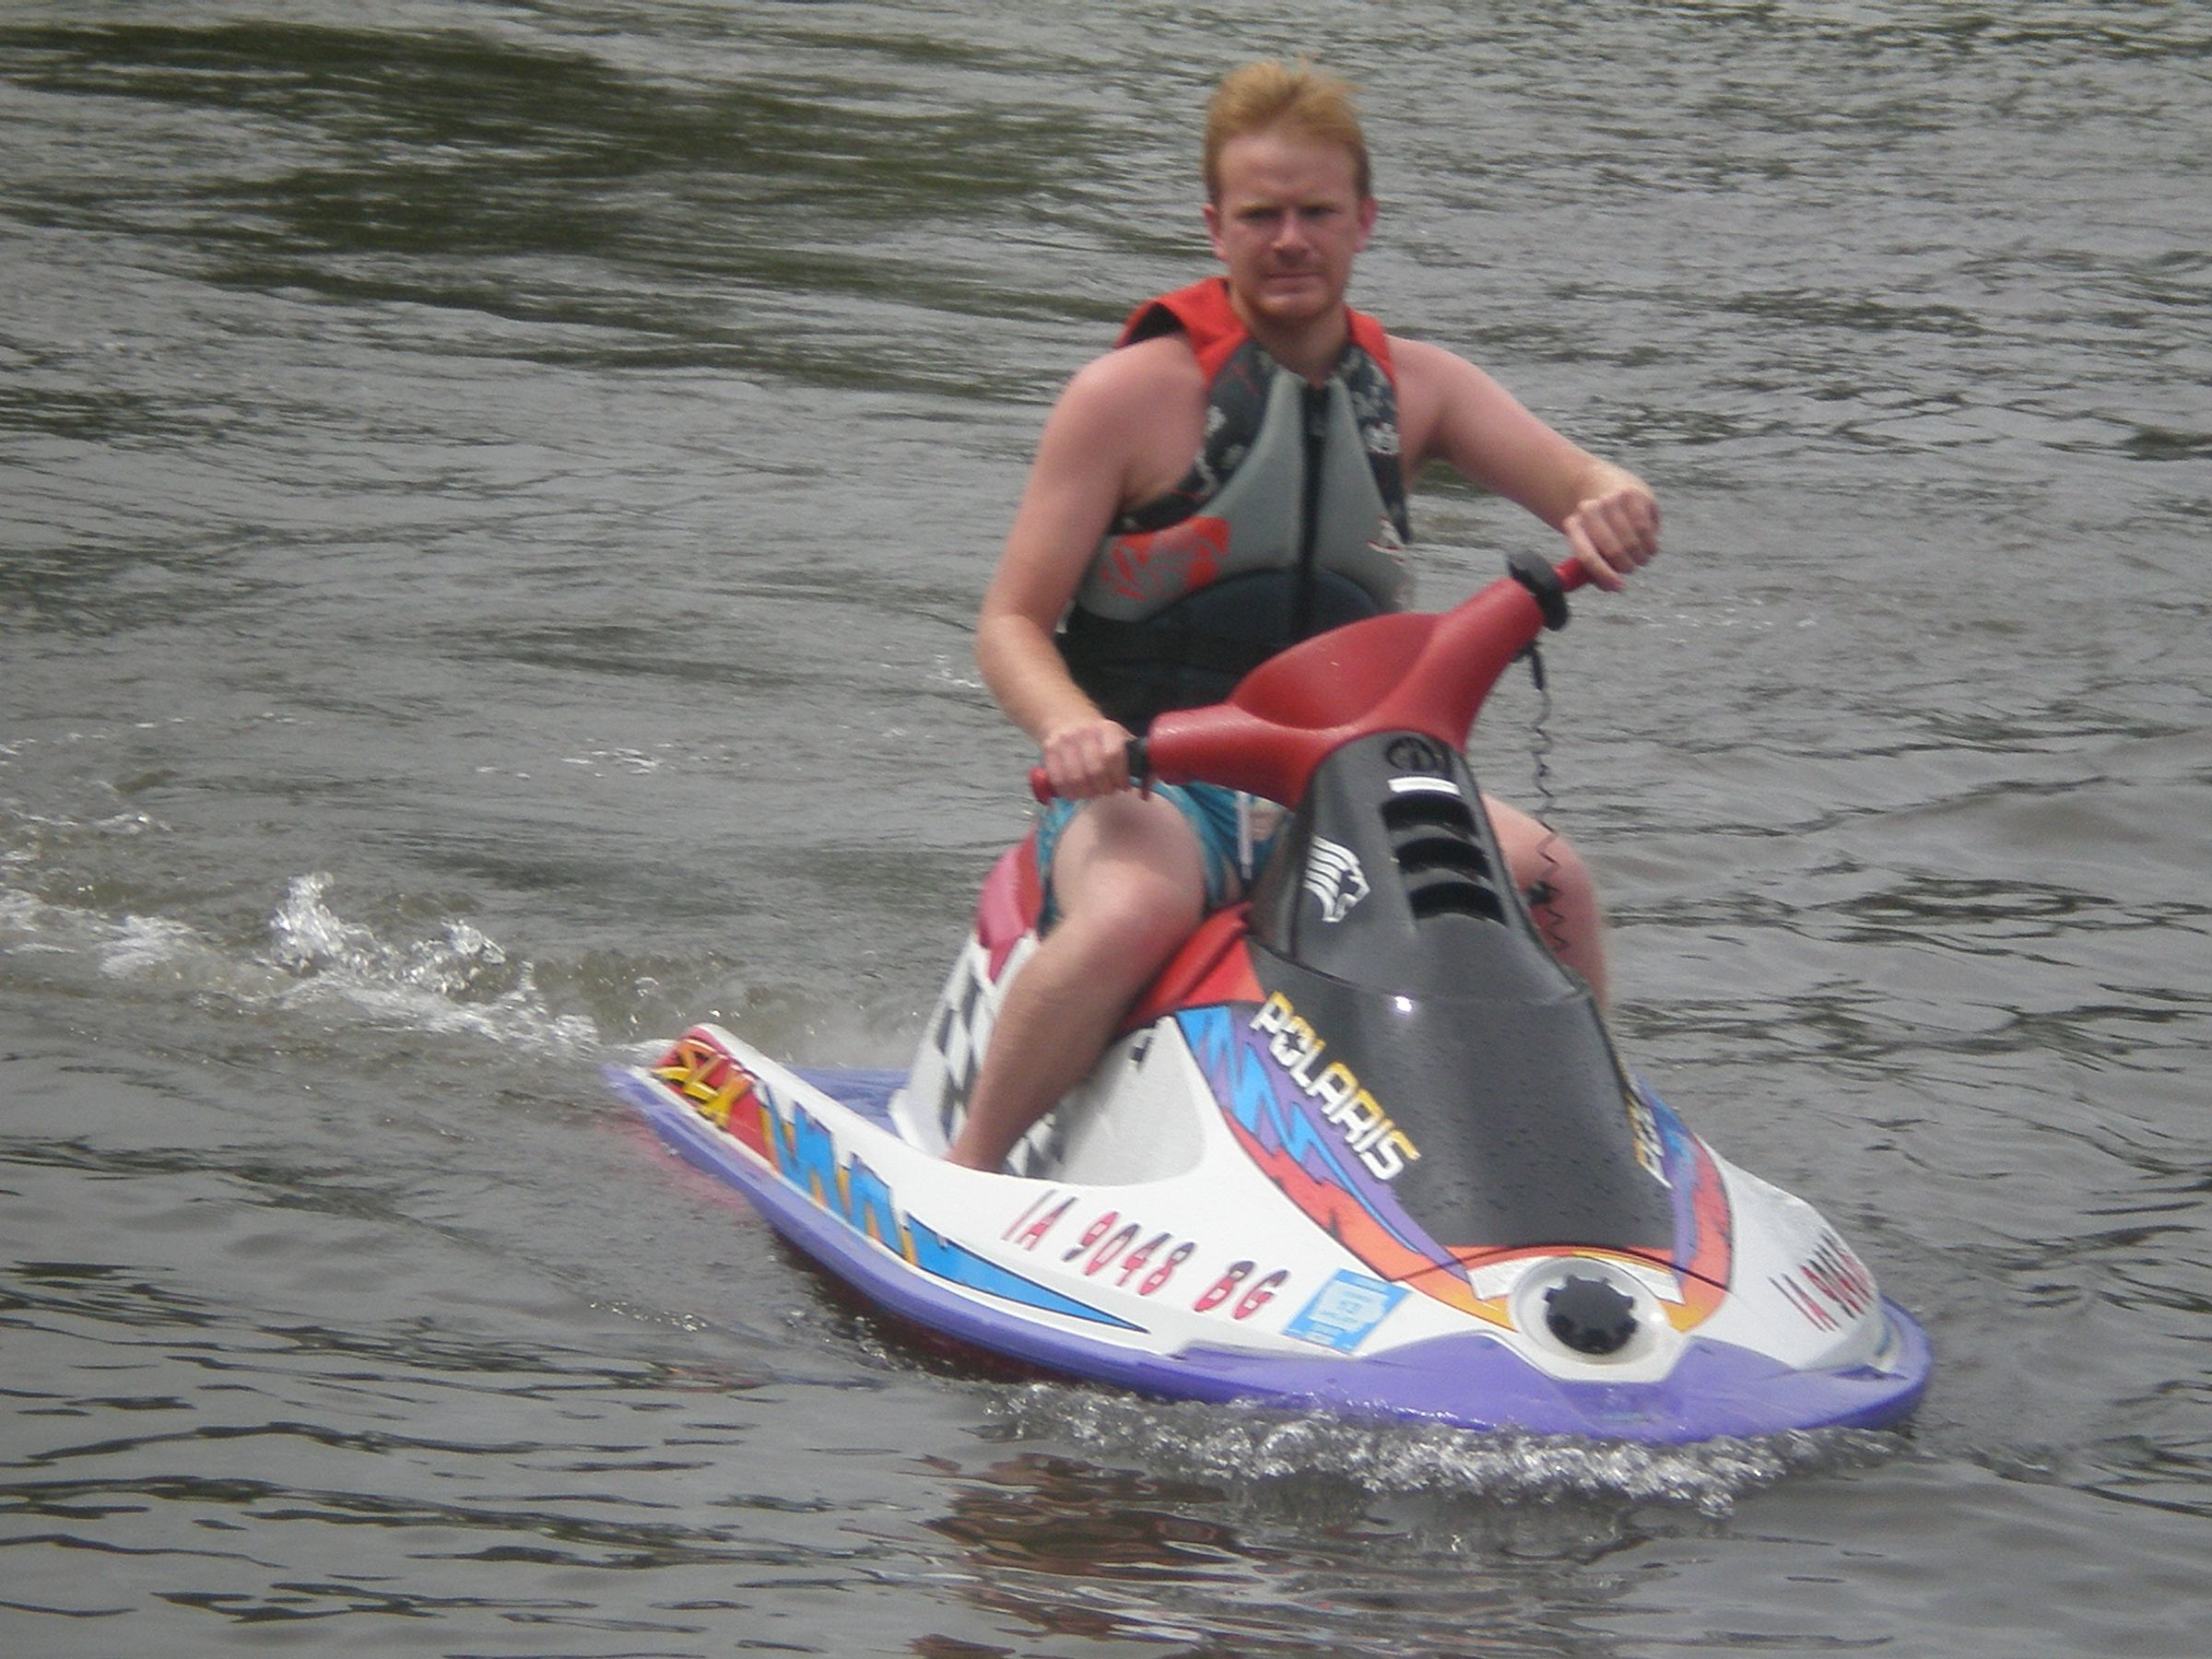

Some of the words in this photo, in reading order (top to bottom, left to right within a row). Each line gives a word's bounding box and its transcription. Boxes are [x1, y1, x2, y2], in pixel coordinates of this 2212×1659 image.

[1249, 990, 1422, 1181] POLARIS
[1002, 1189, 1077, 1252] IA
[1062, 1210, 1196, 1296] 9048
